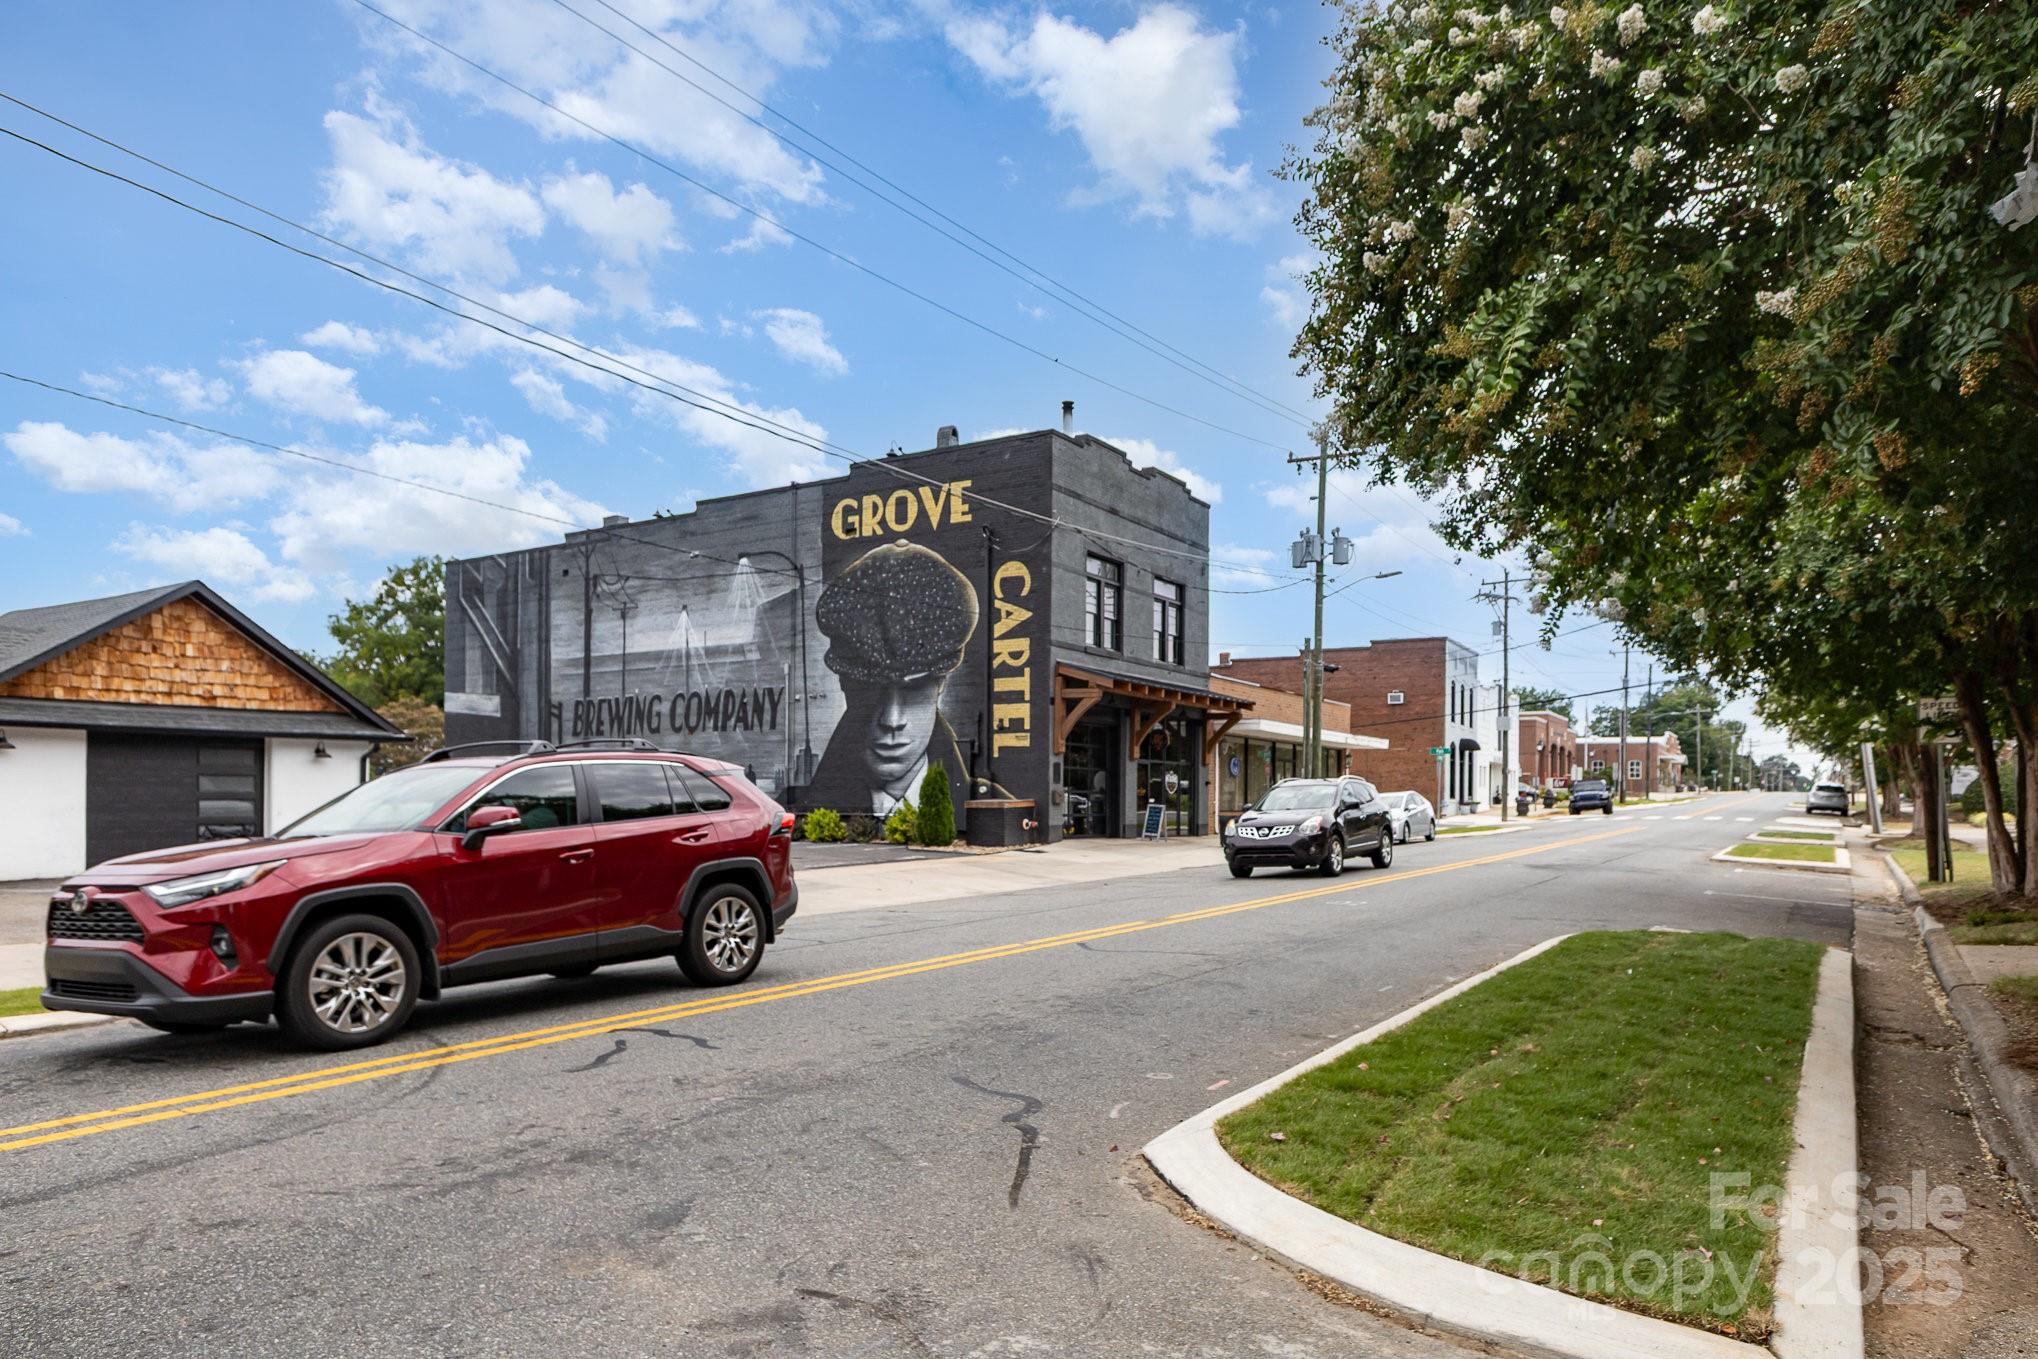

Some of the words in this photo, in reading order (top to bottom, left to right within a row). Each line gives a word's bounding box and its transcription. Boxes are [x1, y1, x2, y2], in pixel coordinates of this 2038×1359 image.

[831, 480, 972, 540] GROVE
[992, 560, 1033, 758] CARTEL
[572, 694, 662, 738] BREWING
[669, 686, 785, 735] COMPANY
